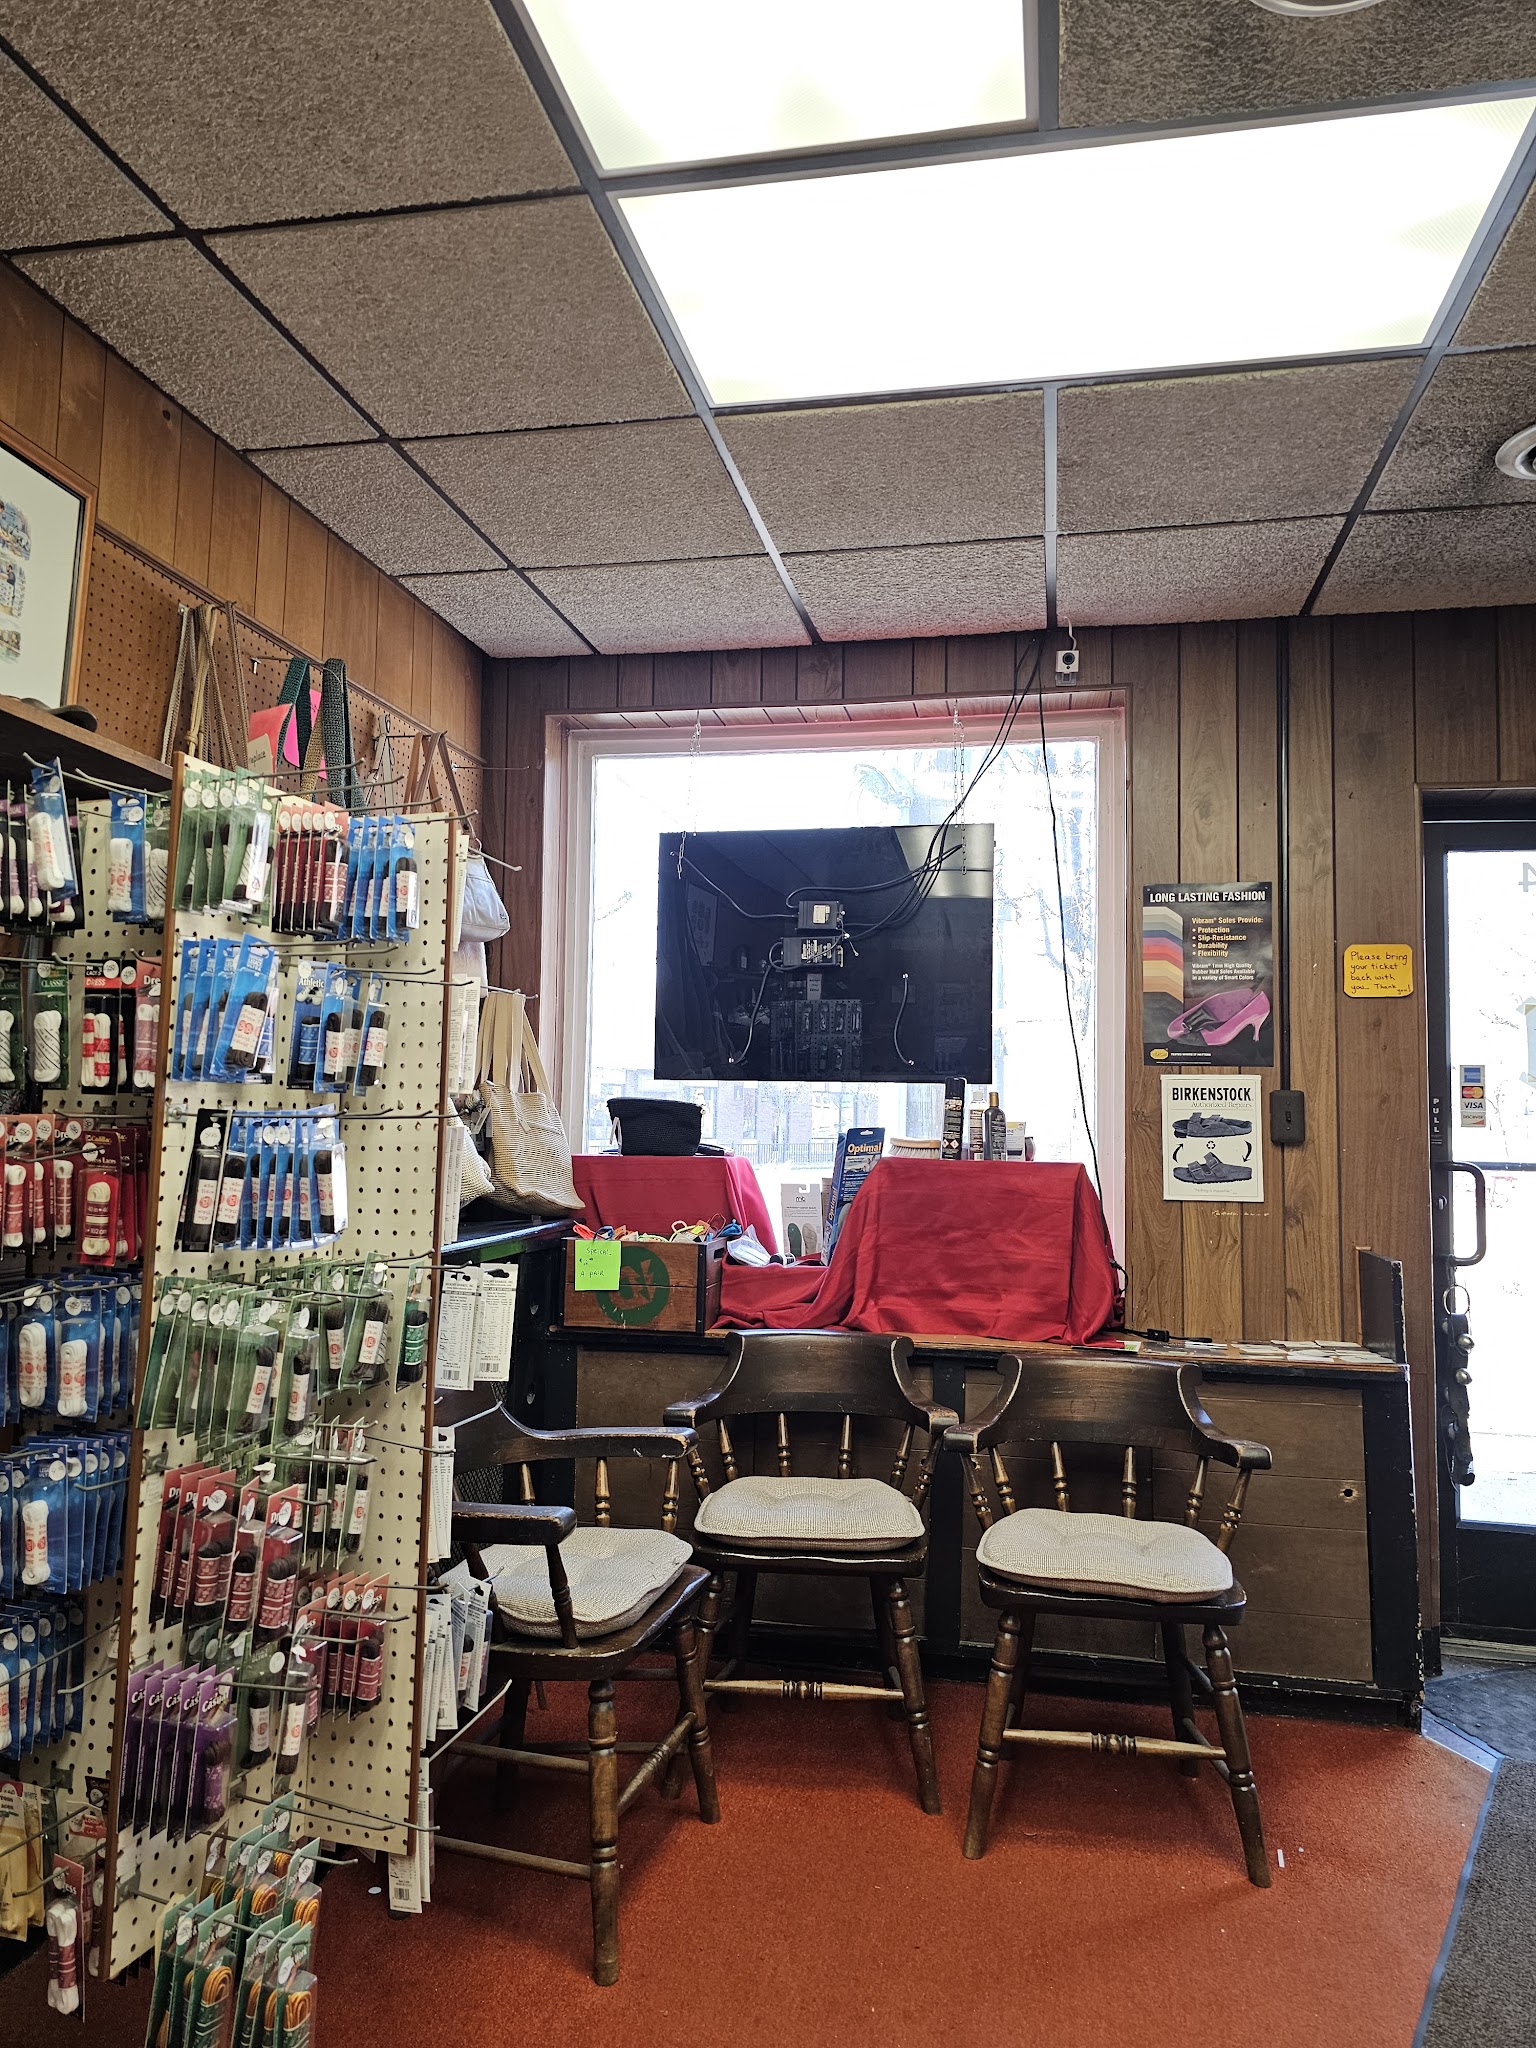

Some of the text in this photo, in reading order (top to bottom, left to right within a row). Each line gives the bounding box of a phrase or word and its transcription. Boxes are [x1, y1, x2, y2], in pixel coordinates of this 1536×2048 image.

[1150, 891, 1266, 903] LONG LASTING FASHION
[1198, 934, 1246, 942] Slip-Resistance
[1198, 942, 1228, 950] Durability
[1198, 950, 1228, 958] Flexibility
[1351, 951, 1408, 966] Please bring
[1350, 965, 1368, 974] your
[41, 979, 65, 988] CLASSIC
[144, 976, 160, 984] Dre
[298, 978, 324, 988] Athletic
[1172, 1088, 1252, 1101] BIRKENSTOCK
[1432, 1098, 1440, 1132] PULL
[54, 1129, 69, 1138] Dre
[847, 1142, 882, 1156] Optimal
[828, 1186, 838, 1220] Optimal
